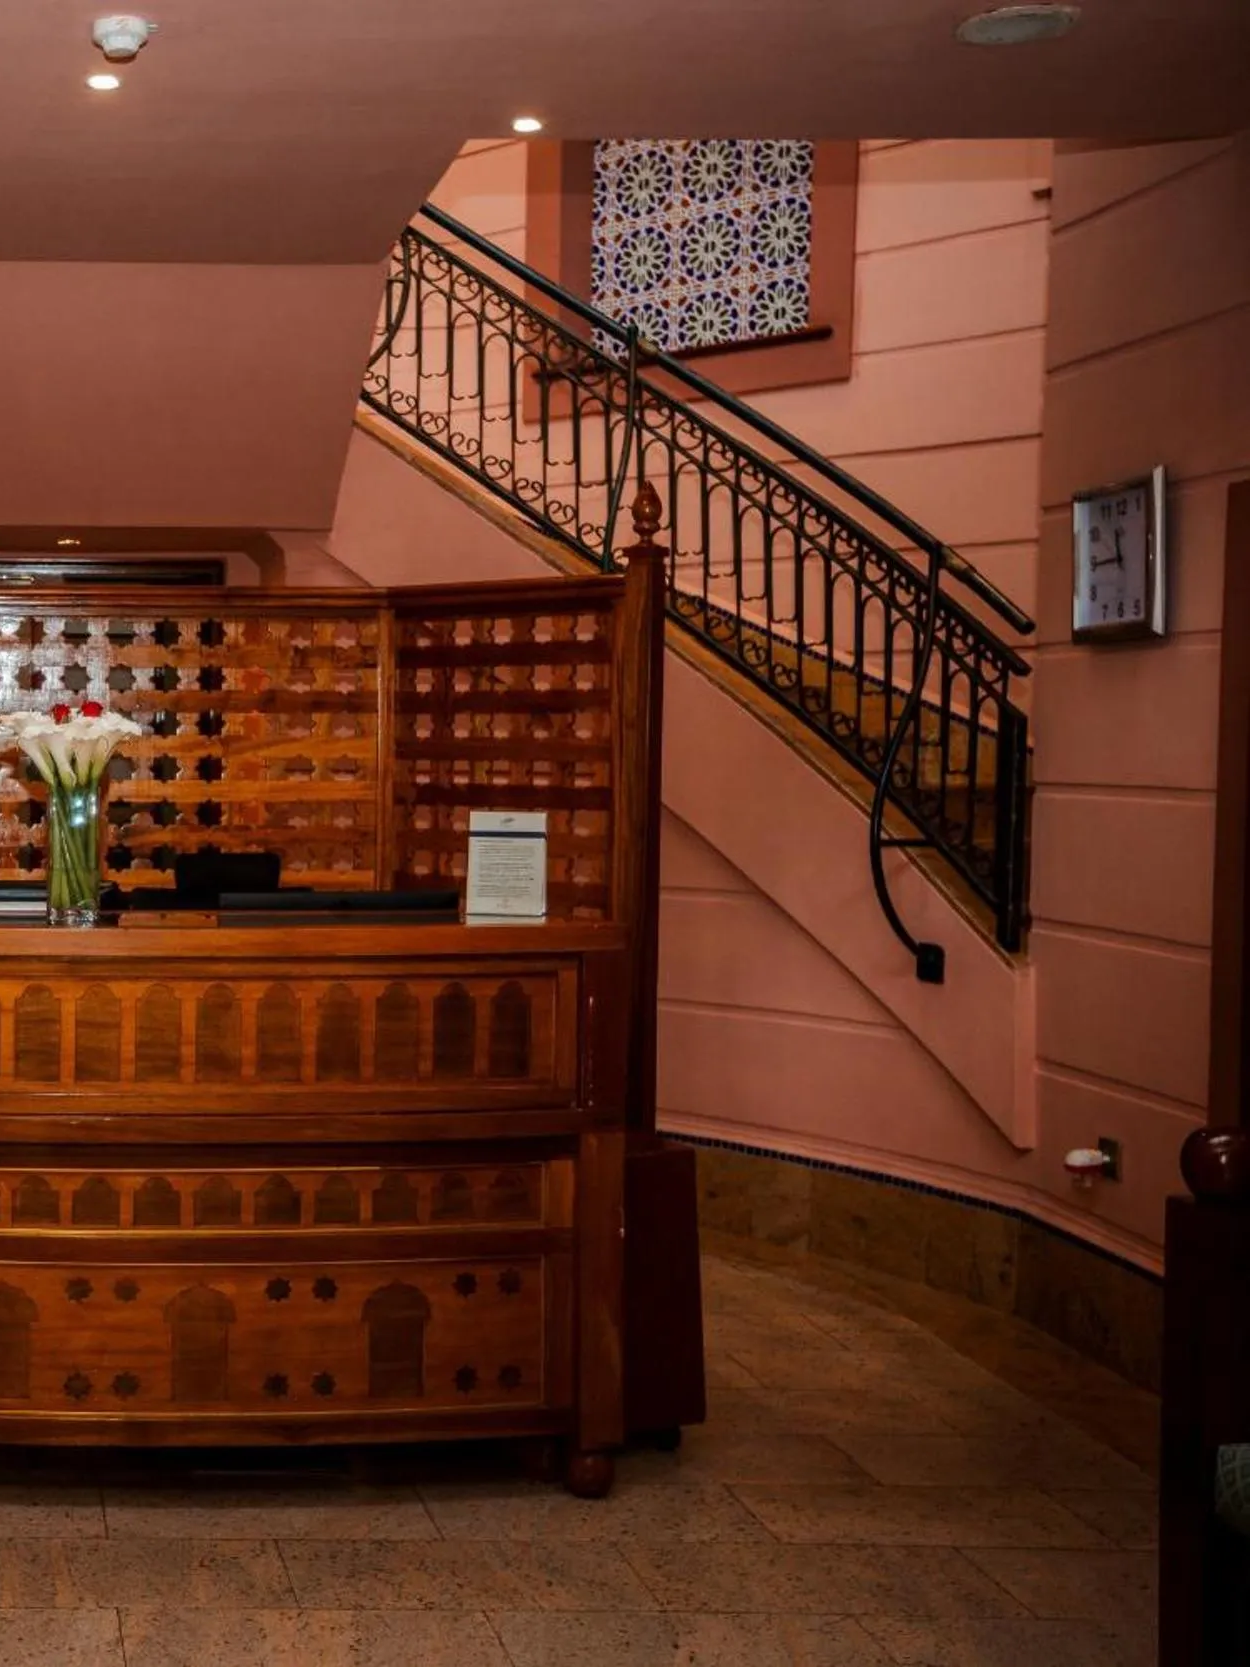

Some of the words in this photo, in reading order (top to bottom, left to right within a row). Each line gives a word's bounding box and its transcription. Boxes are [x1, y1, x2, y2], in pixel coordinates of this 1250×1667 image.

[1100, 502, 1112, 520] 11
[1116, 498, 1128, 516] 12
[1089, 525, 1101, 543] 10
[1090, 554, 1098, 572] 9
[1090, 585, 1098, 602] 8
[1102, 603, 1109, 620] 7
[1117, 601, 1125, 618] 6
[1133, 598, 1141, 616] 5
